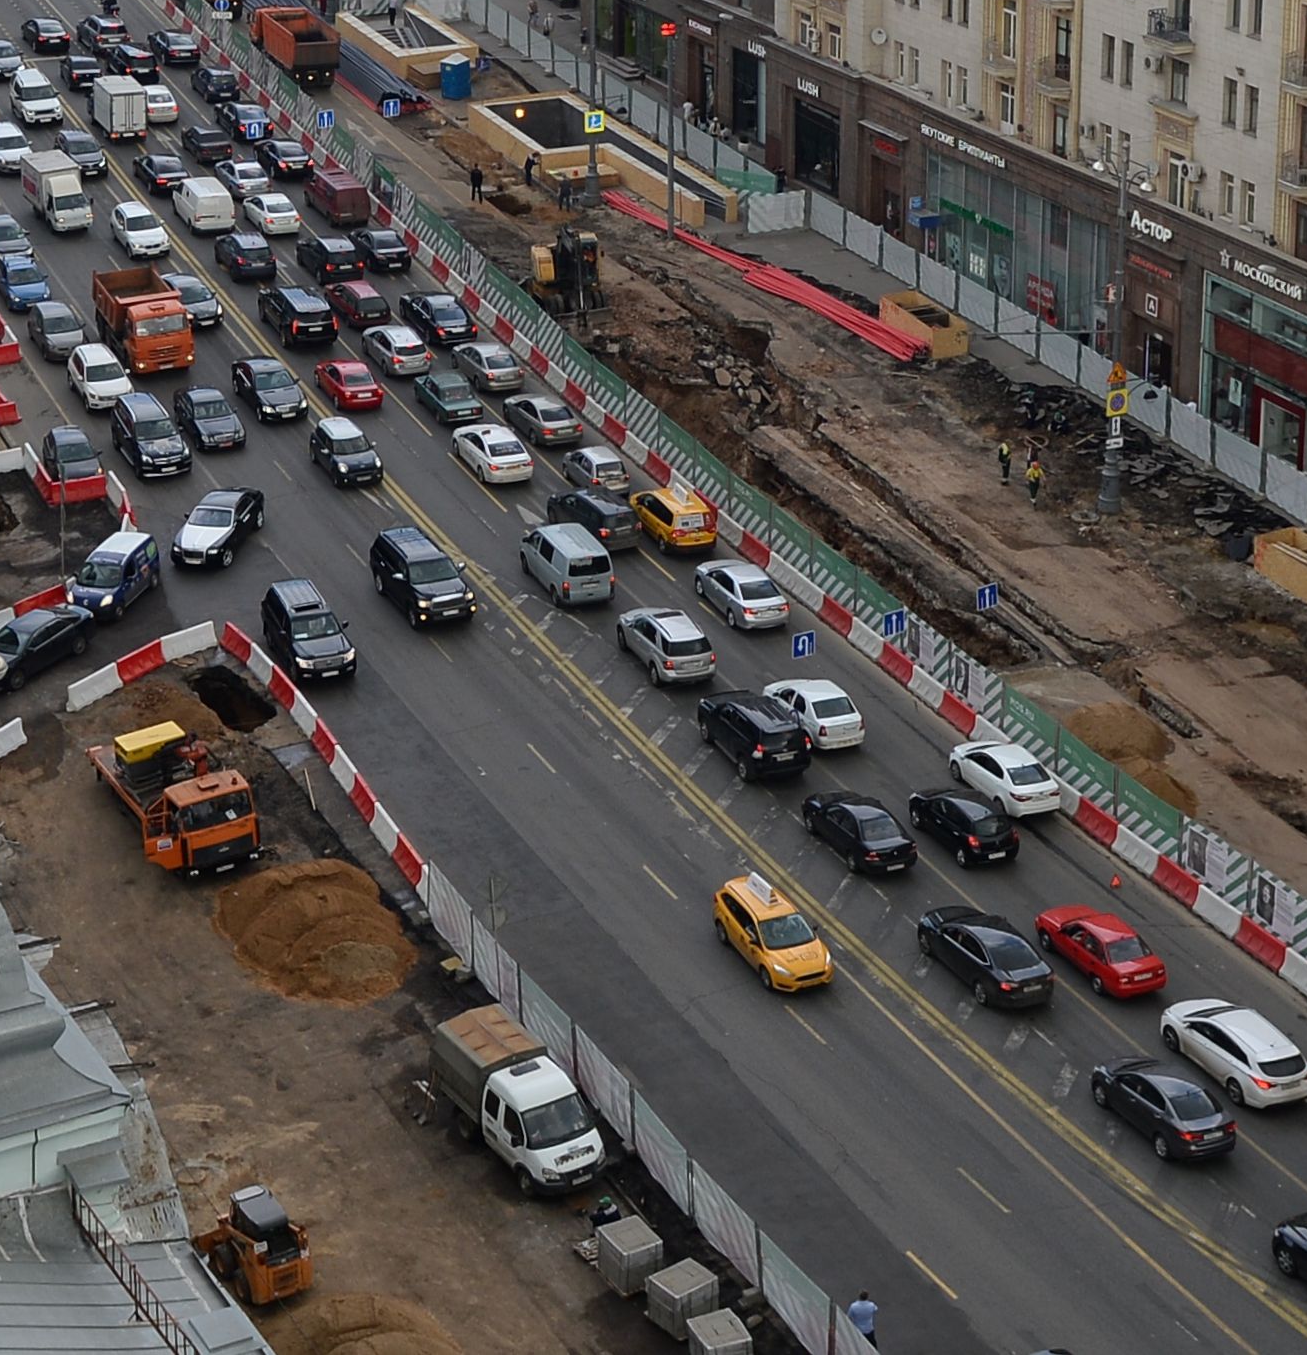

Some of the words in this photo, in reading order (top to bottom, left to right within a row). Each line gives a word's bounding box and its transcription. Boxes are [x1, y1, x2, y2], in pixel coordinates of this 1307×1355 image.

[797, 77, 819, 98] LUSH
[920, 123, 955, 147] ЯКУТСКИЕ
[958, 139, 1005, 168] БРИЛЛИАНТЫ
[1233, 259, 1302, 301] МОСКОВСКИЙ
